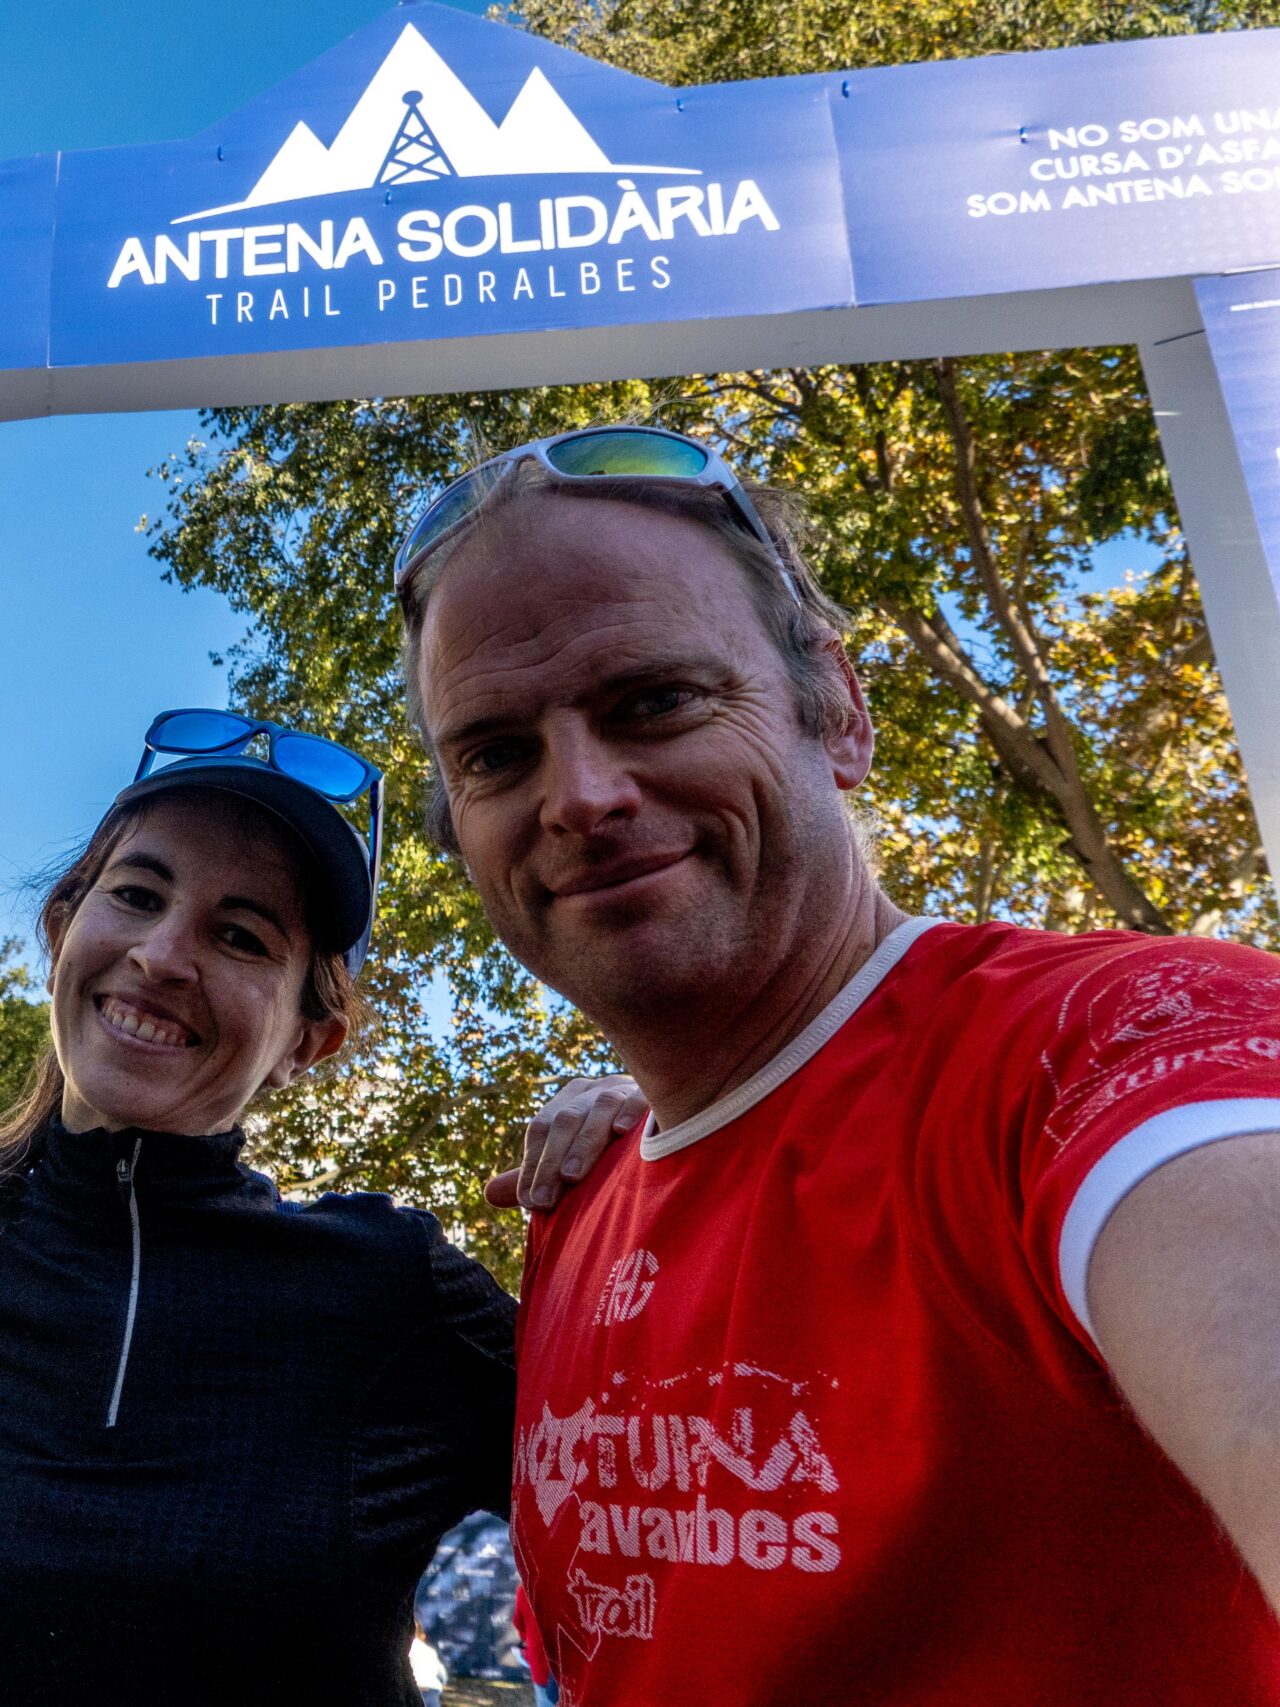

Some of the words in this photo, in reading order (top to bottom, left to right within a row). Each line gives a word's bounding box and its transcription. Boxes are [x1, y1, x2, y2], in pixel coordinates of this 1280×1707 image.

[1048, 124, 1109, 150] NO
[1119, 114, 1205, 143] SOM
[1214, 107, 1280, 134] UN
[1030, 150, 1150, 181] CURSA
[966, 188, 1051, 218] SOM
[1062, 174, 1213, 210] ANTENA
[107, 217, 383, 288] ANTENA
[397, 179, 780, 262] SOLIDÀRIA
[206, 287, 340, 325] TRAIL
[379, 256, 671, 311] PEDRALBES
